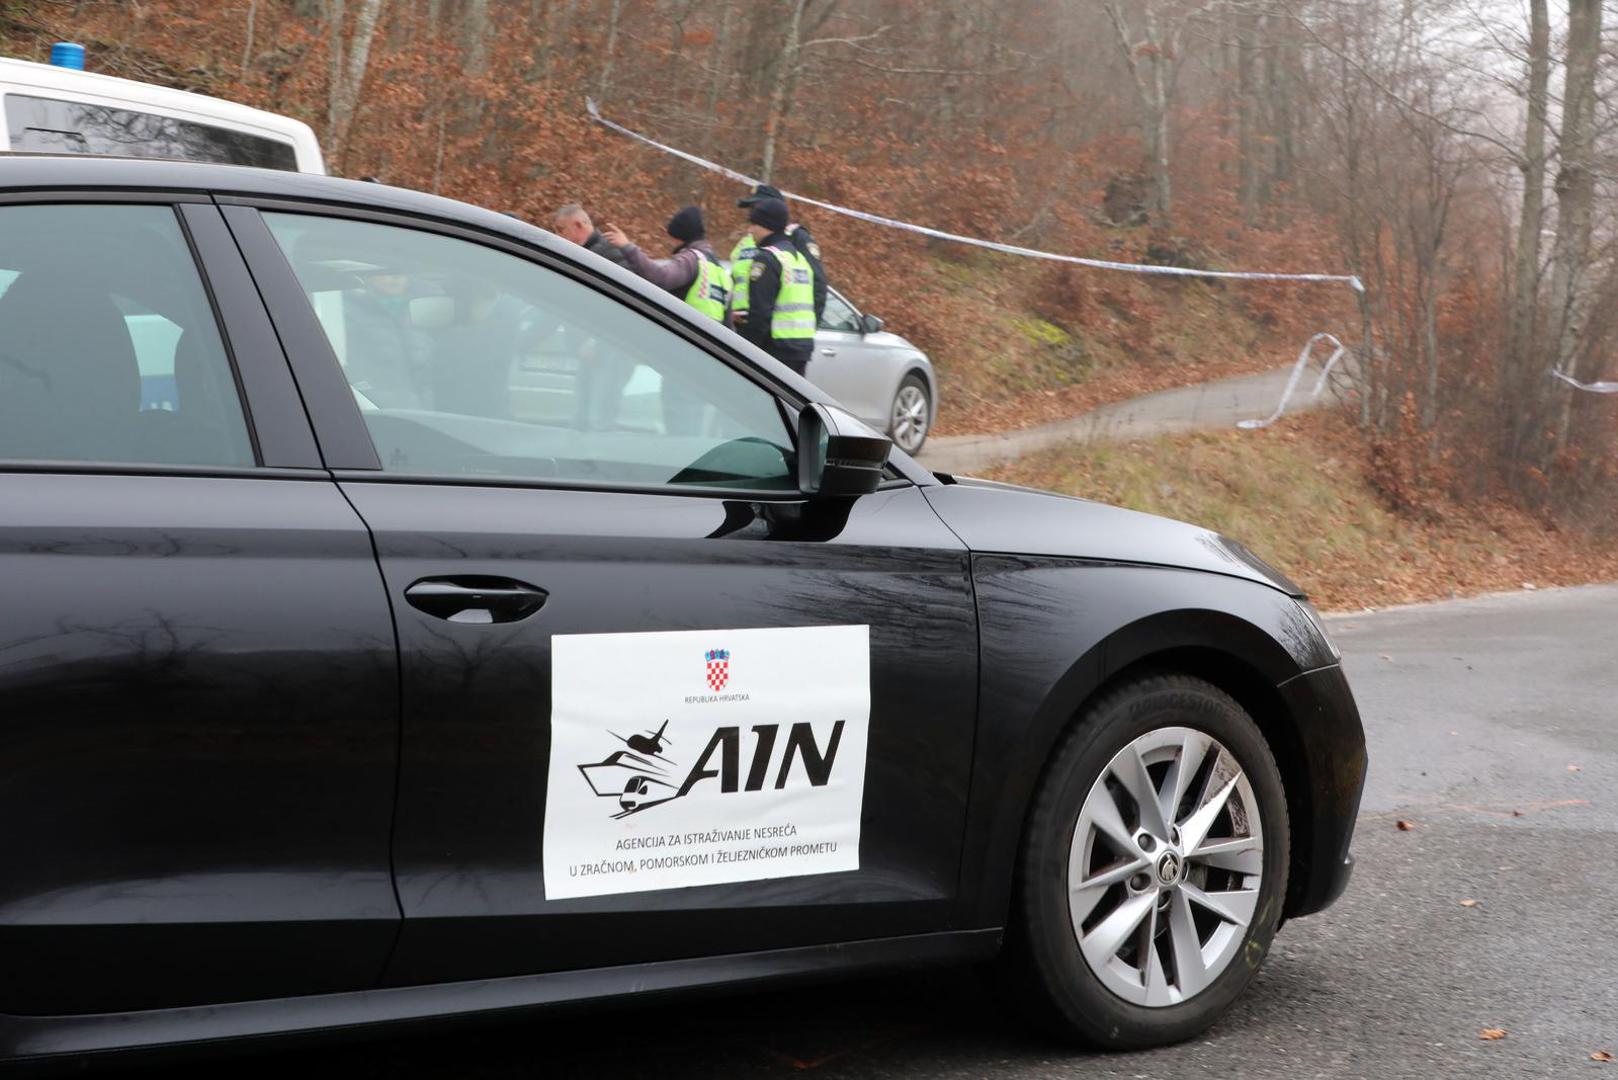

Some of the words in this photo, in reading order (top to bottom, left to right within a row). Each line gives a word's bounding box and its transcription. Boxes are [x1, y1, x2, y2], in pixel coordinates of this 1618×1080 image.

[684, 695, 718, 704] REPUBLIKA
[720, 694, 750, 702] HRVATSKA
[616, 836, 665, 850] AGENCIJA
[668, 834, 681, 846] ZA
[684, 829, 751, 845] ISTRAŽIVANJE
[754, 823, 797, 839] NESREĆA
[569, 865, 578, 877] U
[580, 860, 637, 876] ZRAČNOM,
[640, 854, 709, 871] POMORSKOM
[711, 854, 715, 864] I
[717, 846, 788, 864] ŽELJEZNIČKOM
[790, 842, 838, 857] PROMETU
